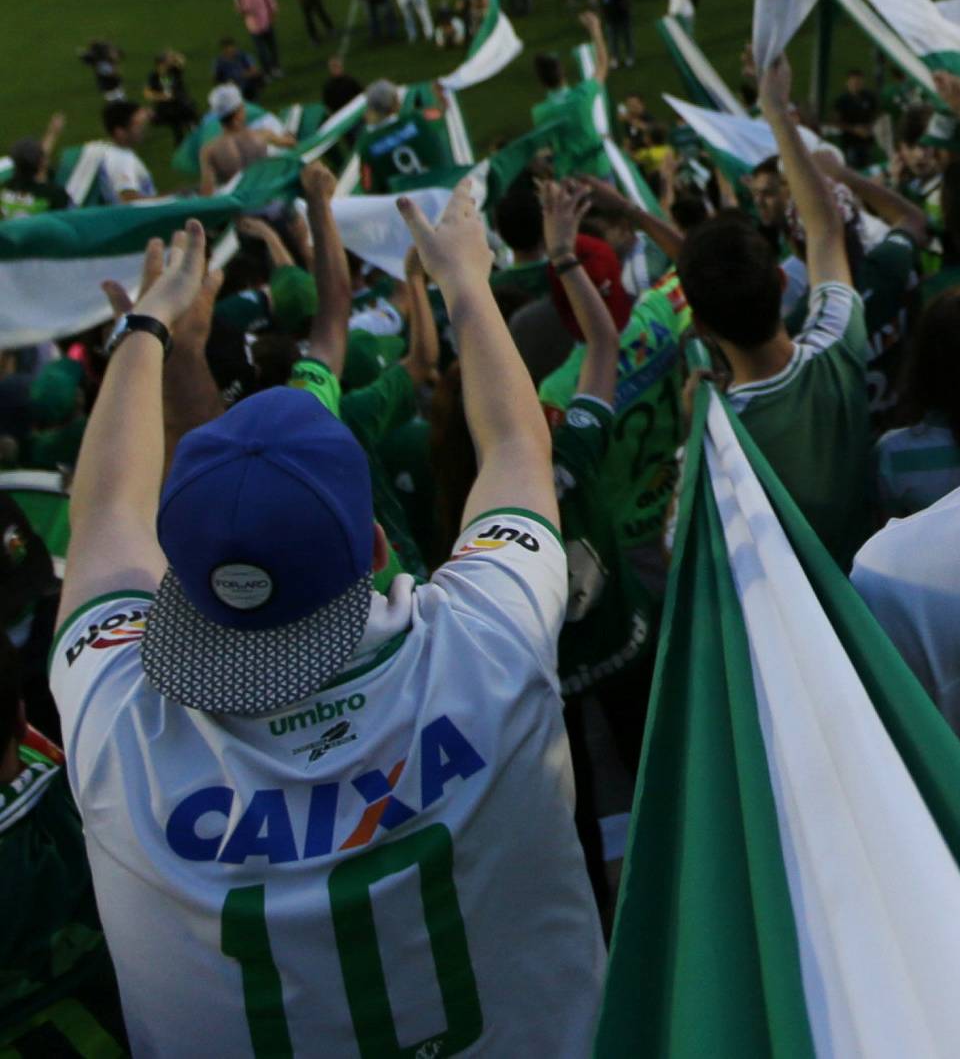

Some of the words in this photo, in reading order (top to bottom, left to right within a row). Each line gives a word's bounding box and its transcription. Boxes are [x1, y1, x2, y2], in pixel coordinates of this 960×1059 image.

[478, 524, 540, 552] aur
[66, 610, 149, 667] rora
[269, 692, 366, 737] umbro
[166, 714, 487, 865] CAIXA
[221, 822, 484, 1059] 10
